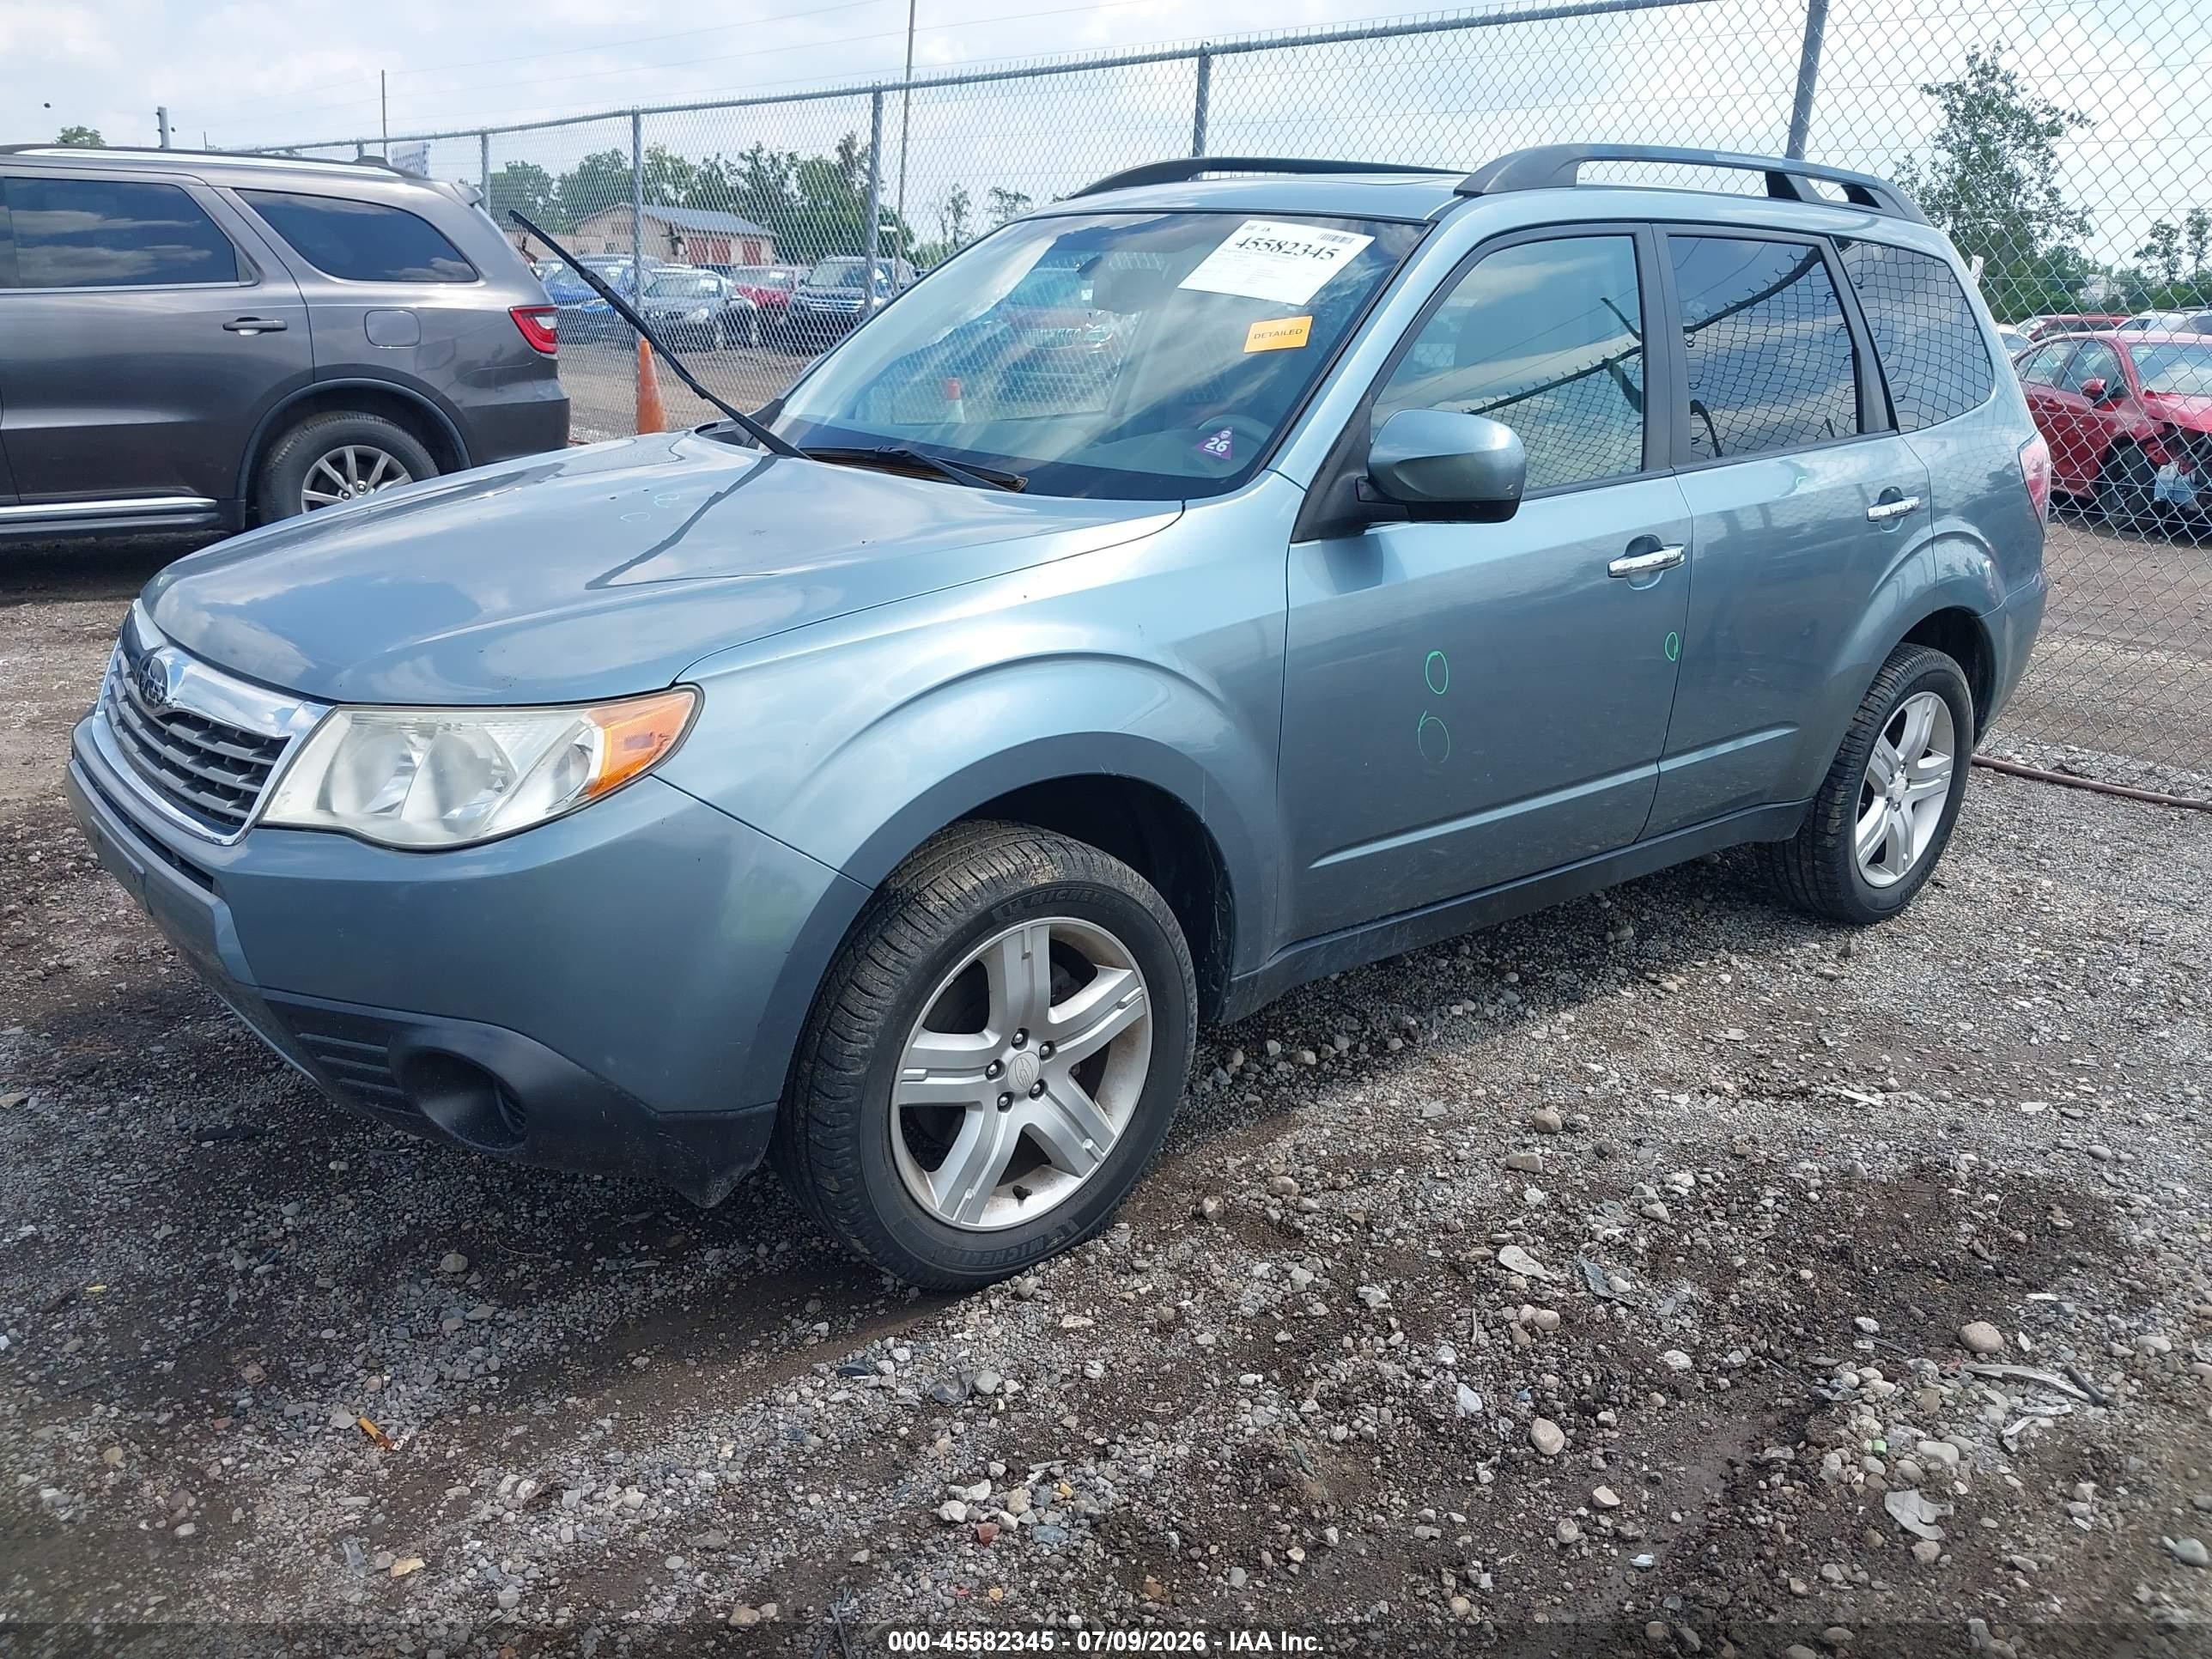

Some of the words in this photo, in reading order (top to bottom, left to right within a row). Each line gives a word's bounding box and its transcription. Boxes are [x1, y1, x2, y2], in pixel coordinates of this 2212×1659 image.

[1235, 237, 1340, 260] 45582345
[1254, 328, 1304, 340] DETAILED
[1204, 437, 1231, 453] 26
